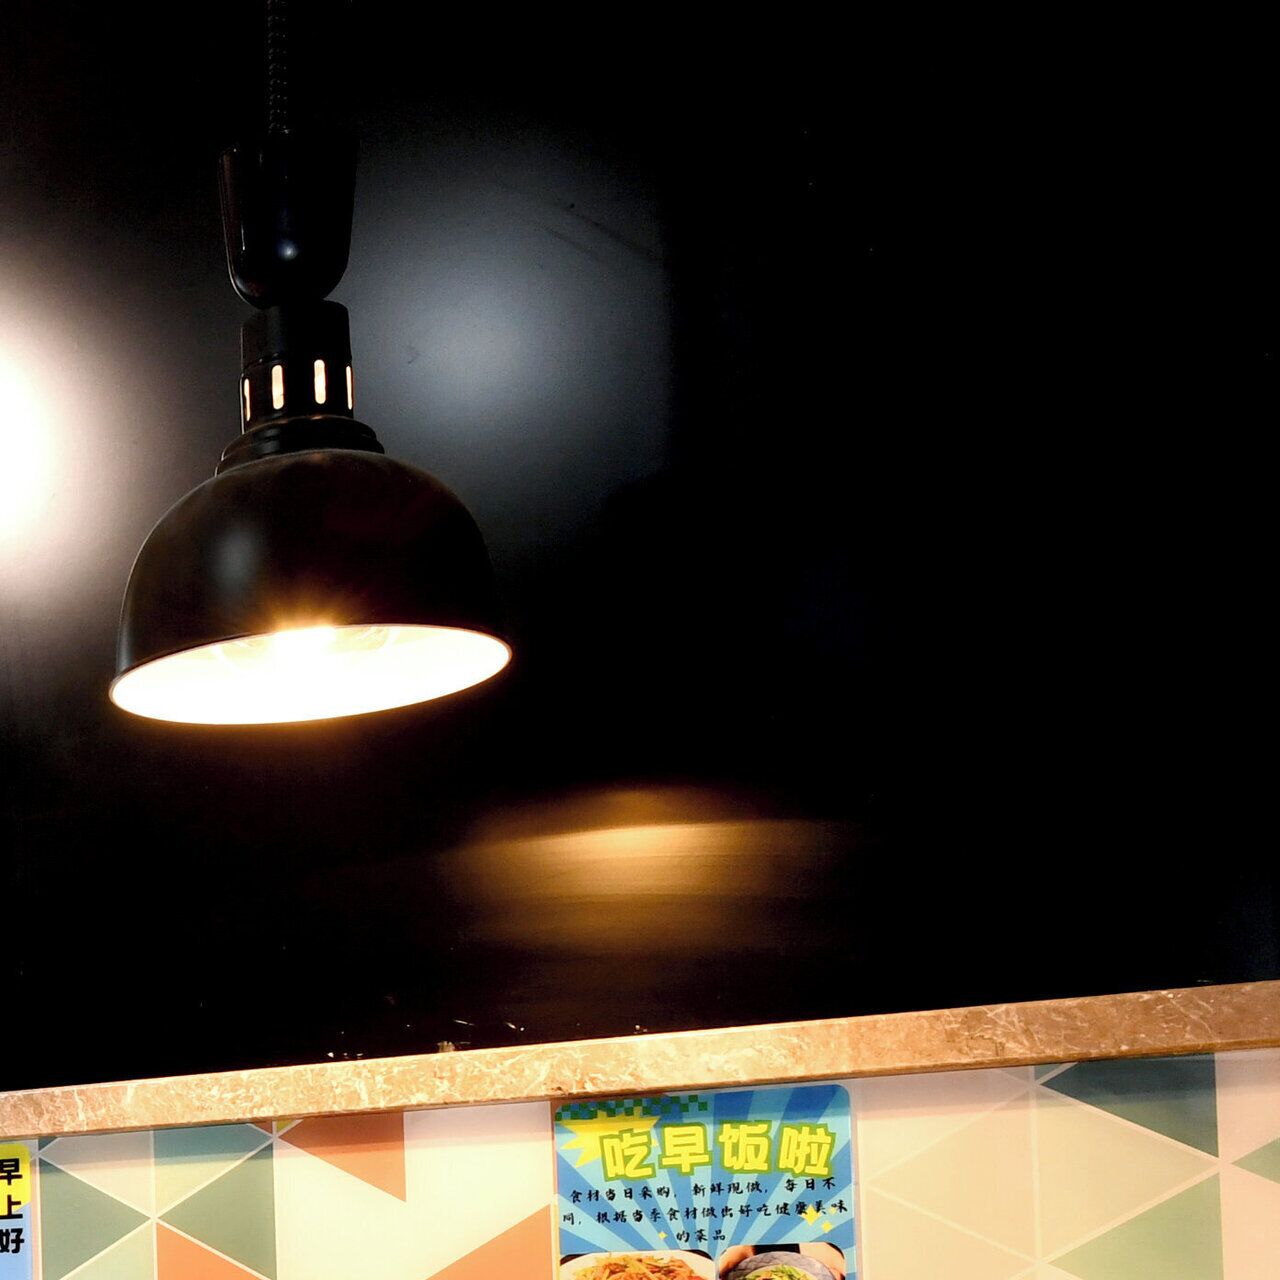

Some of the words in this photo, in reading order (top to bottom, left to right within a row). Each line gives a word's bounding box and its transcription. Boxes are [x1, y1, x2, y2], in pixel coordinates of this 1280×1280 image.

[598, 1120, 836, 1181] 吃早饭啦
[676, 1228, 727, 1243] 的菜品
